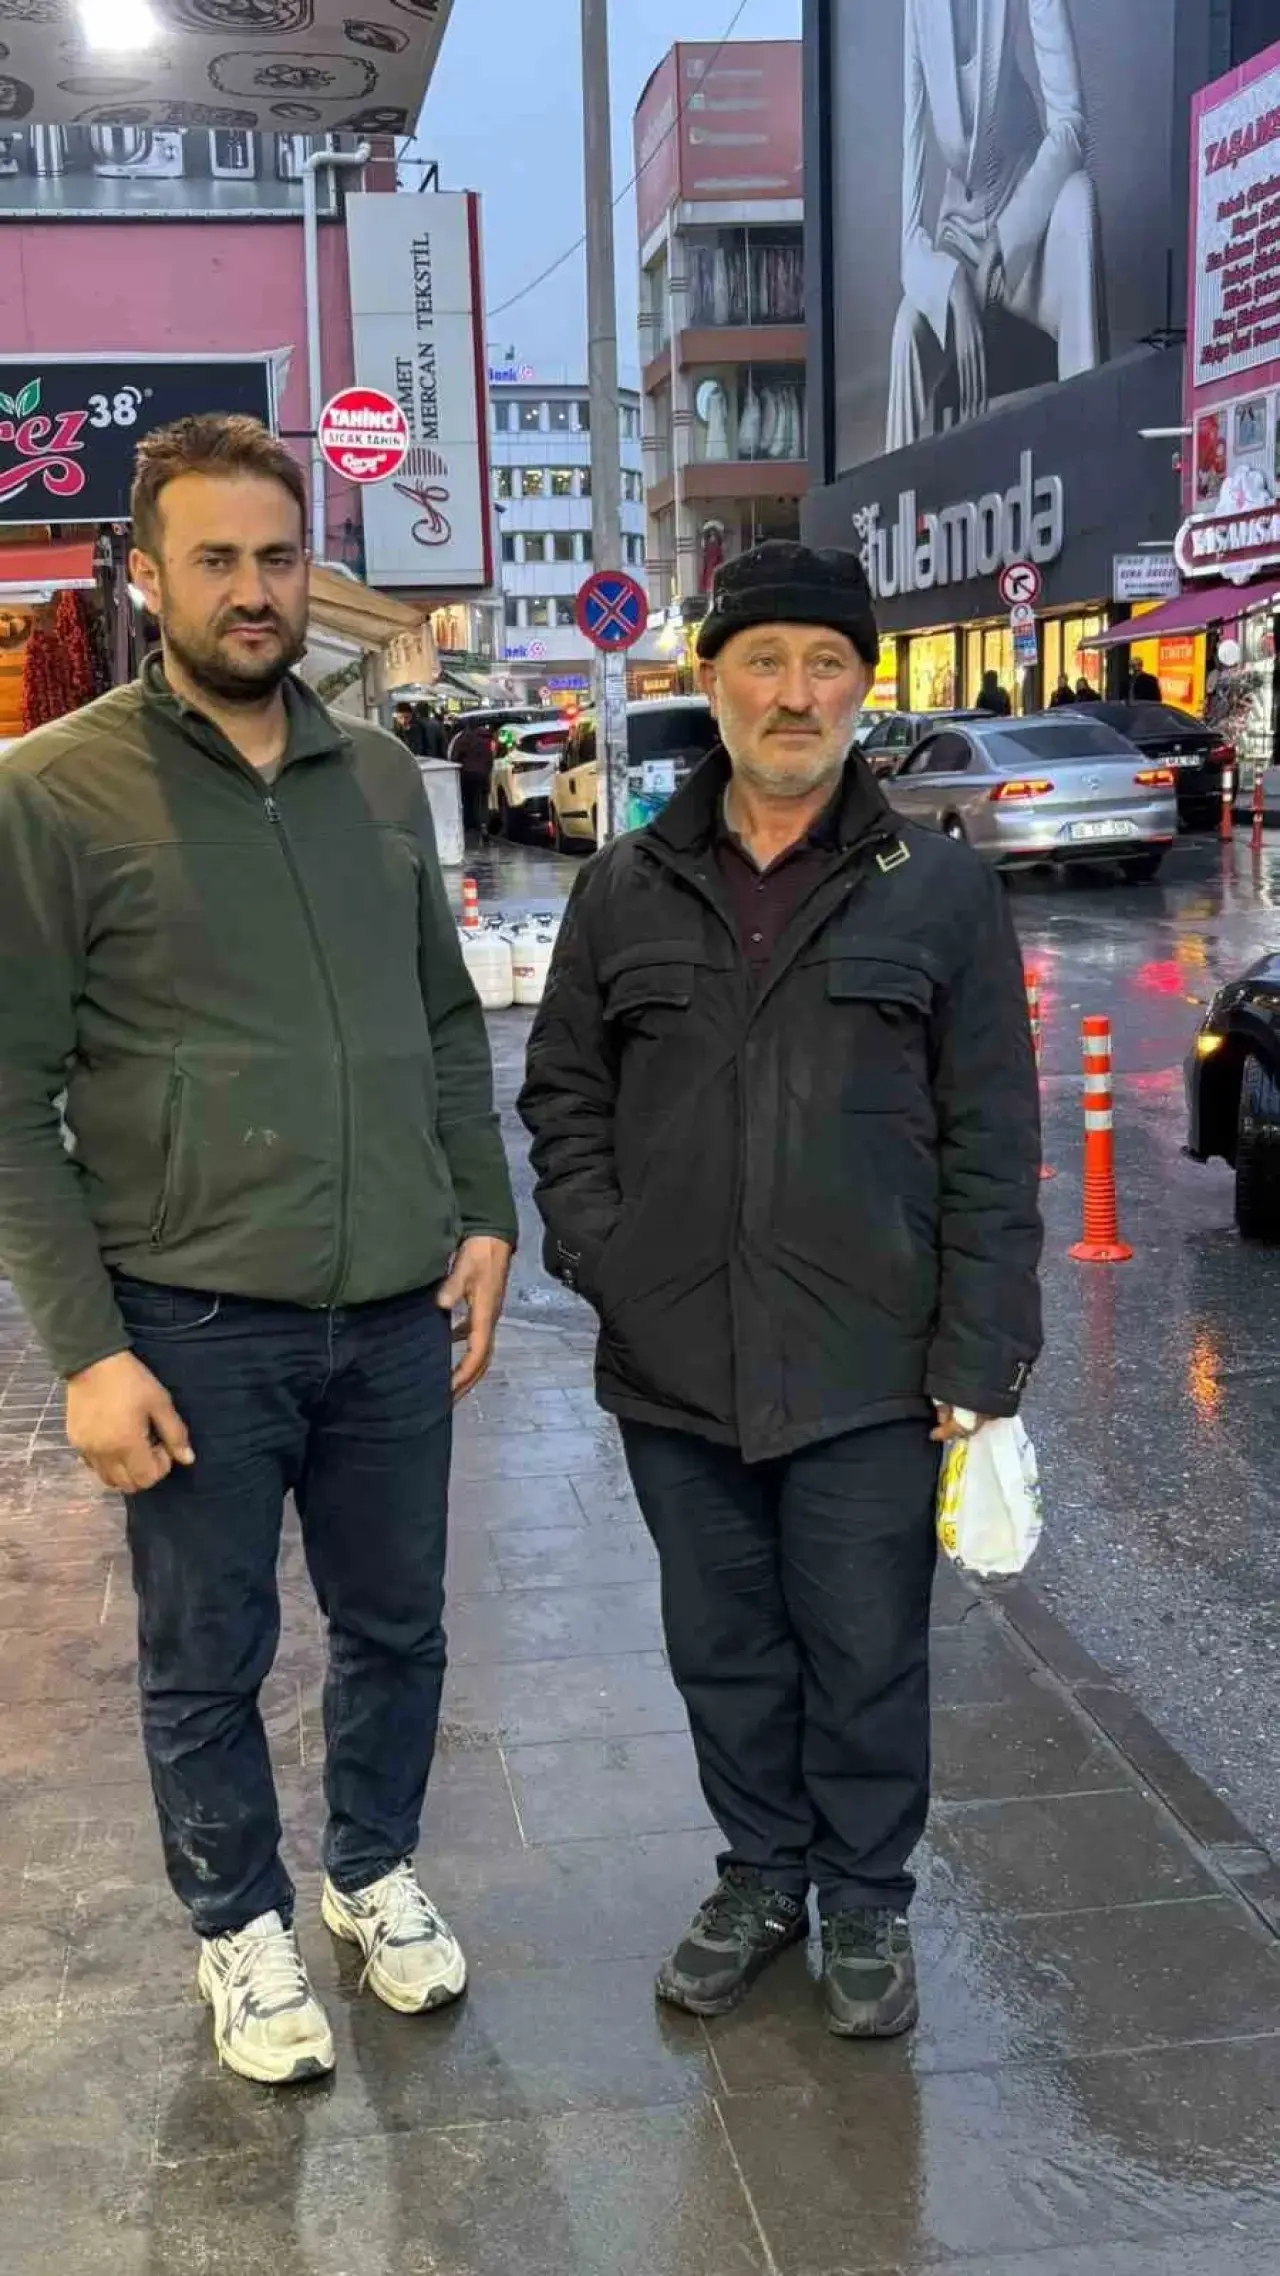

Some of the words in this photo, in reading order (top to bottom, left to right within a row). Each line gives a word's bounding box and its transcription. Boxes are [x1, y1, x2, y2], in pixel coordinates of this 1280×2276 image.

[410, 232, 433, 330] TEKSTİL
[88, 392, 137, 428] 38
[418, 342, 438, 441] MERCAN
